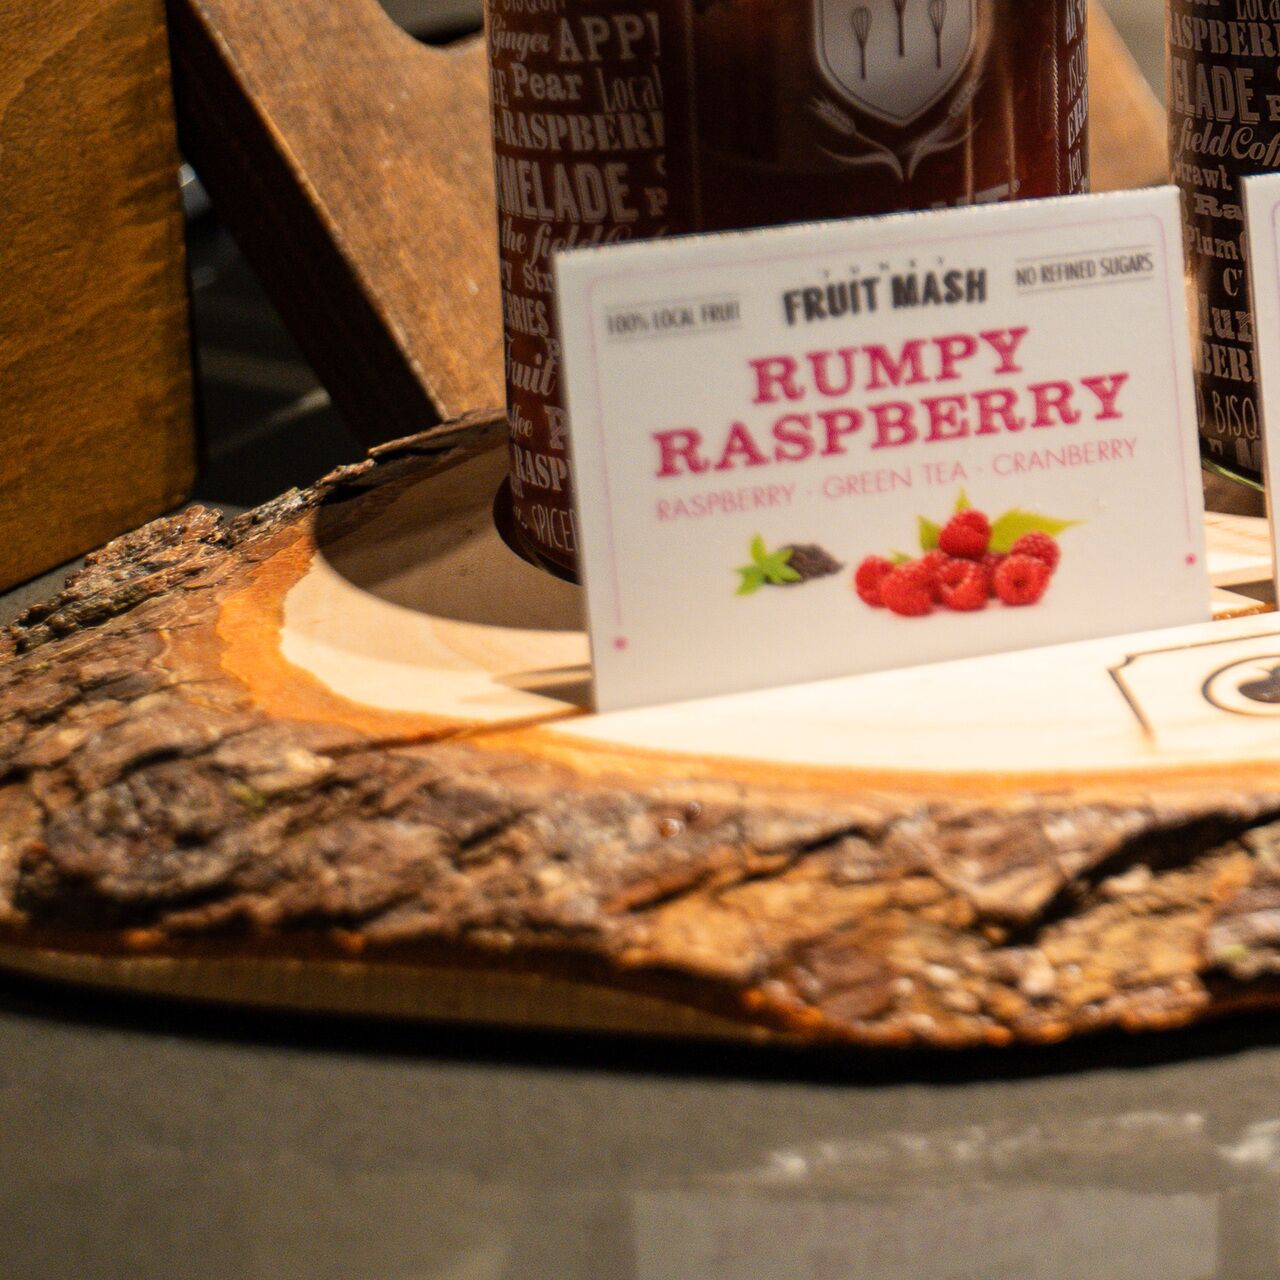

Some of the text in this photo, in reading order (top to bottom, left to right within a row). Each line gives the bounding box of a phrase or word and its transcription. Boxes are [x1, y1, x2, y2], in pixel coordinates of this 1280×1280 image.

[510, 62, 584, 102] Pear
[783, 275, 880, 326] FRUIT
[891, 266, 989, 313] MASH
[1014, 251, 1154, 287] NO REFINED SUGARS
[749, 326, 1029, 404] RUMPY
[651, 372, 1130, 479] RASPBERRY
[655, 437, 1139, 522] RASPBERRY GREEN TEA CRANBERRY
